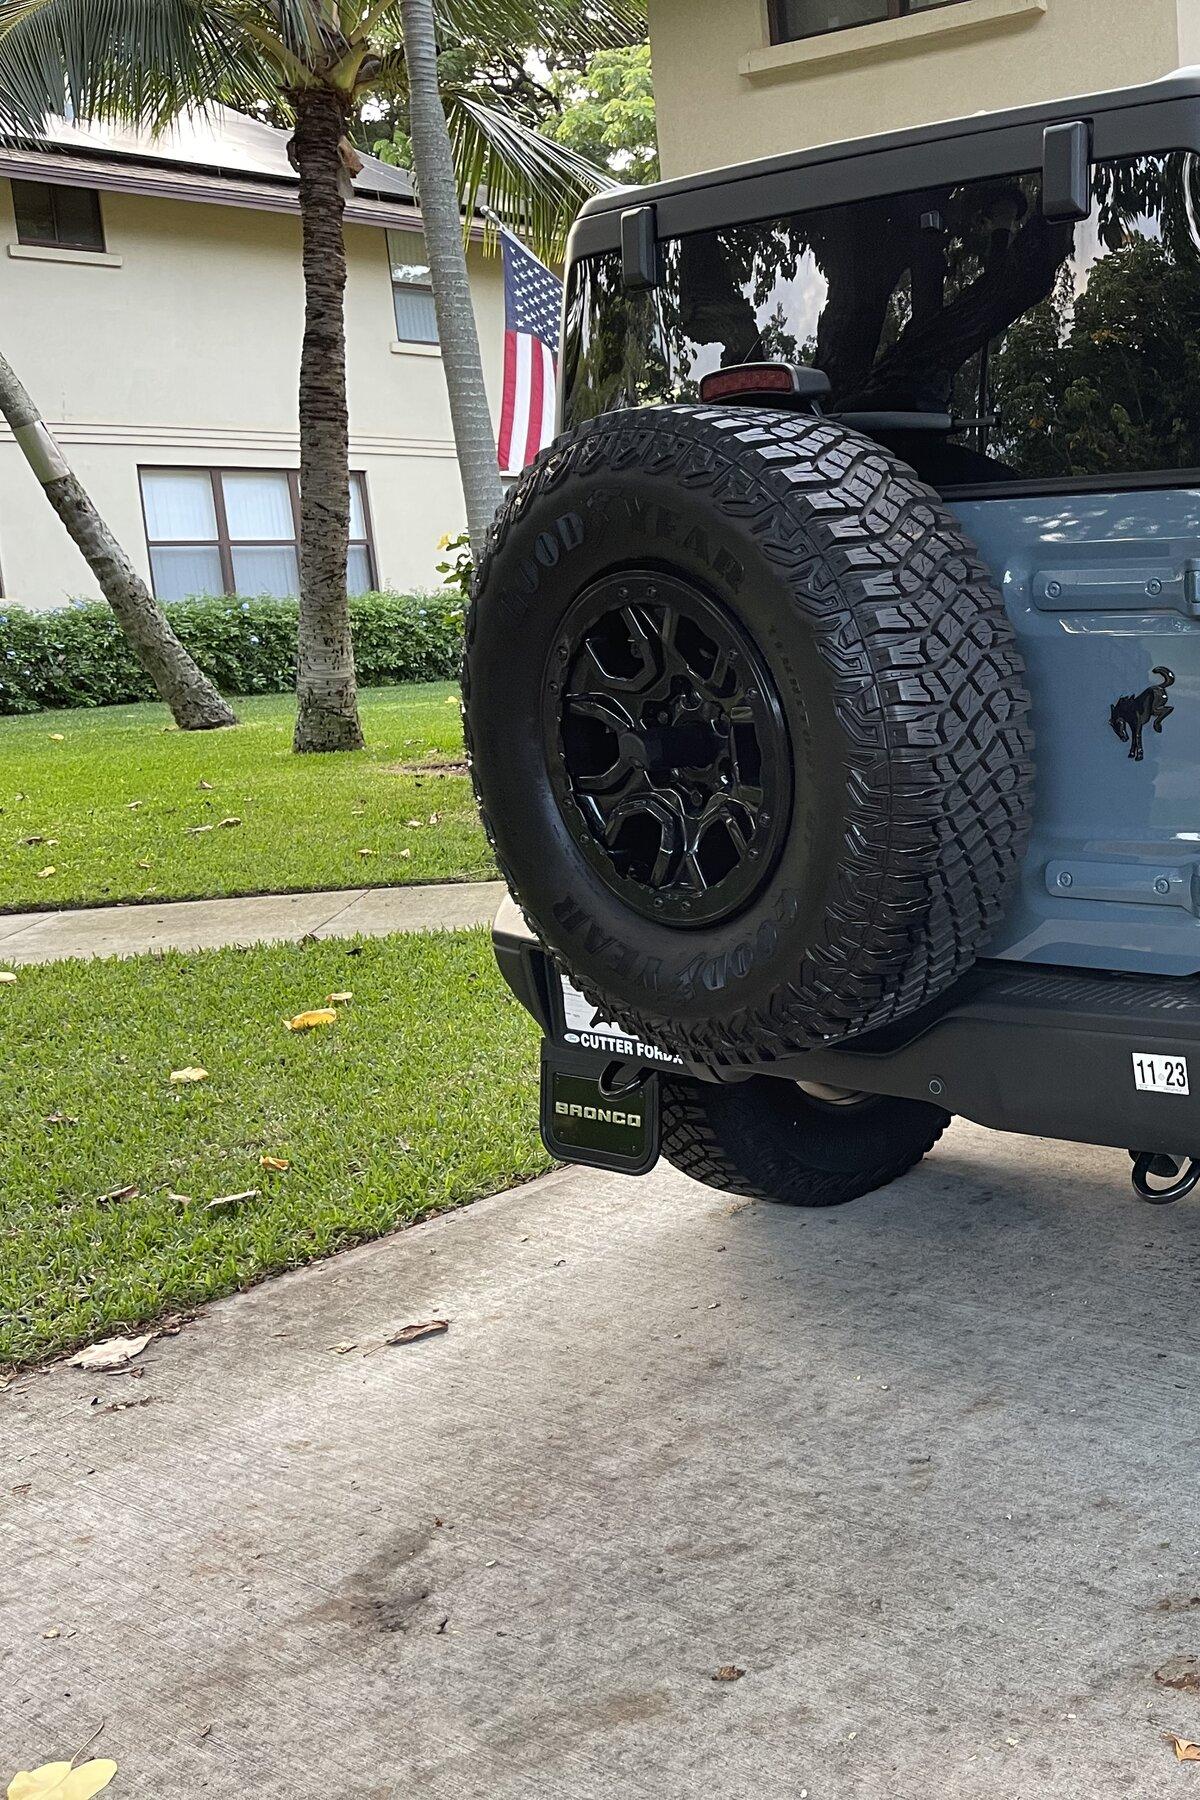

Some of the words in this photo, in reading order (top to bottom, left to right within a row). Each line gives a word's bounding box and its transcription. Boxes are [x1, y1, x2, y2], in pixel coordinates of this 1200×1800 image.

[580, 1033, 633, 1055] CUTTER
[1136, 1059, 1156, 1085] 11
[1164, 1061, 1186, 1088] 23
[555, 1101, 641, 1128] BRONCO
